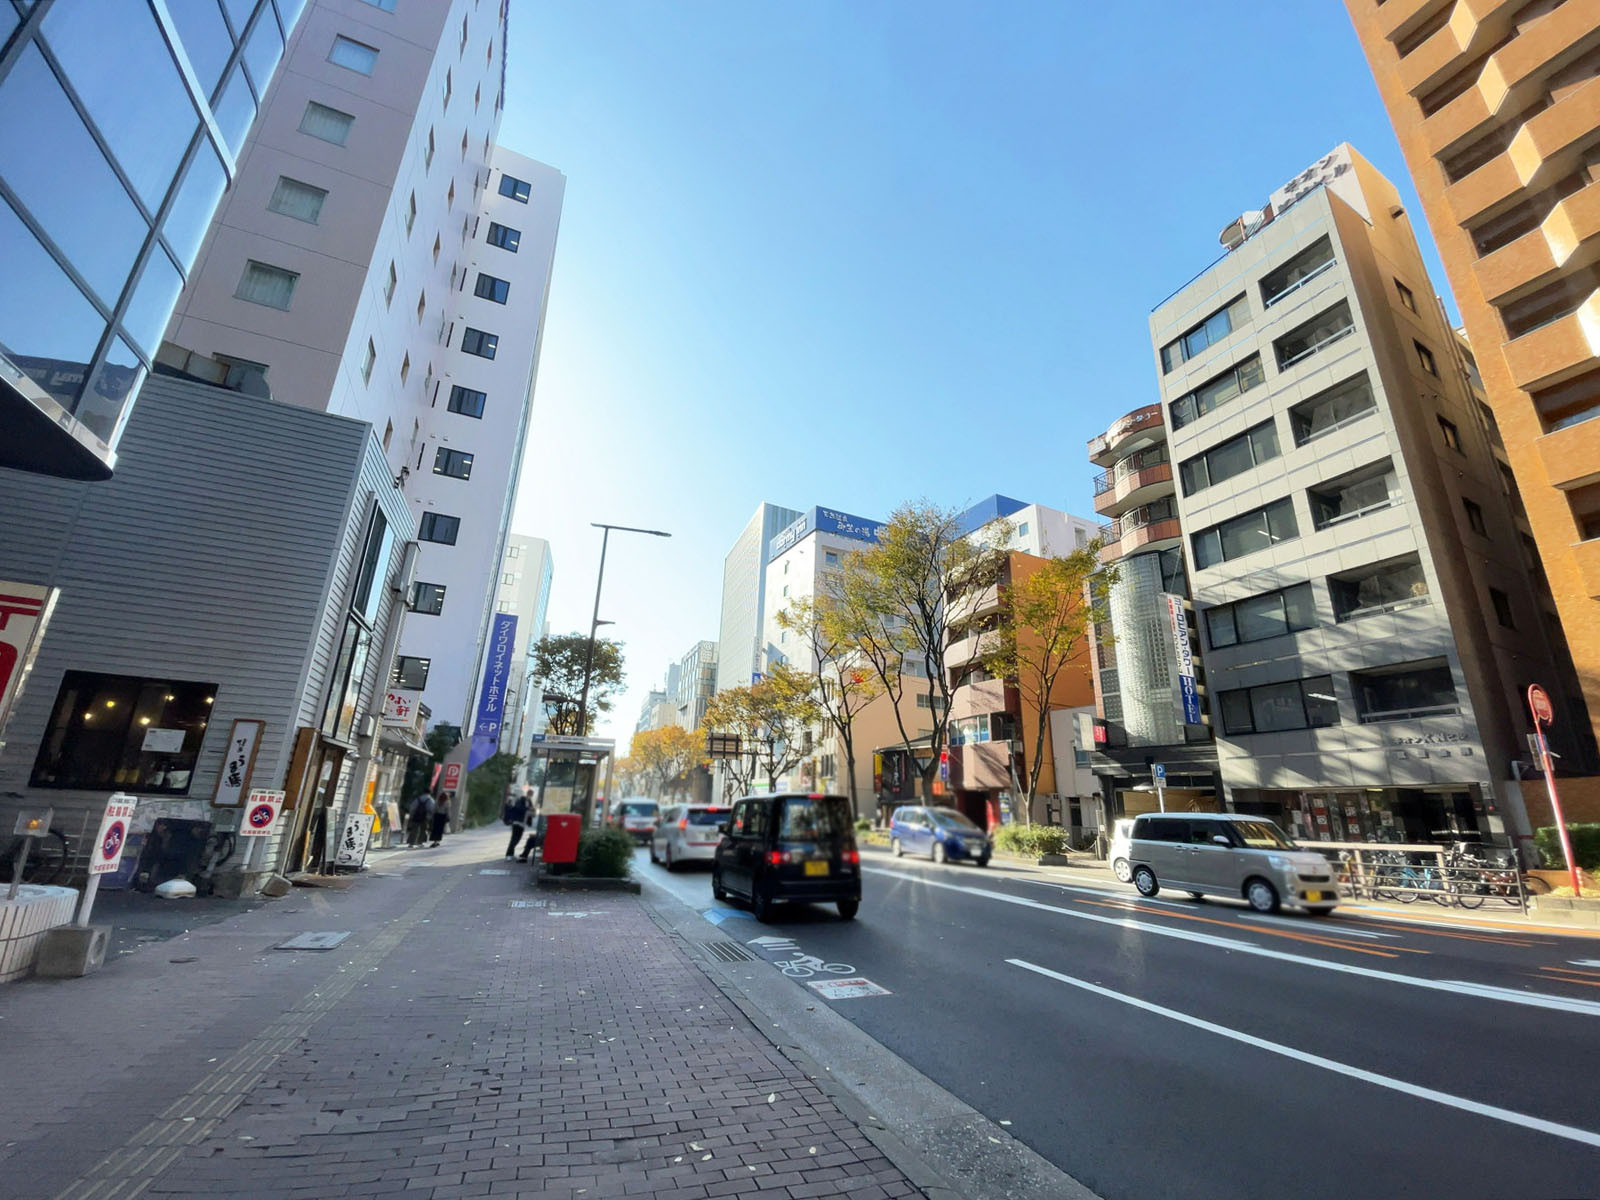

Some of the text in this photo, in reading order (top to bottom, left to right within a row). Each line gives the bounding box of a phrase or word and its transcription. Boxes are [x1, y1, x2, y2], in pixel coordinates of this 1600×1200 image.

[486, 620, 513, 713] ダイワロイネットホテル
[1183, 676, 1198, 723] HOTEL
[488, 722, 498, 733] P
[1156, 765, 1164, 777] P
[250, 794, 283, 804] 駐輪禁止
[106, 805, 136, 817] 駐輪禁止
